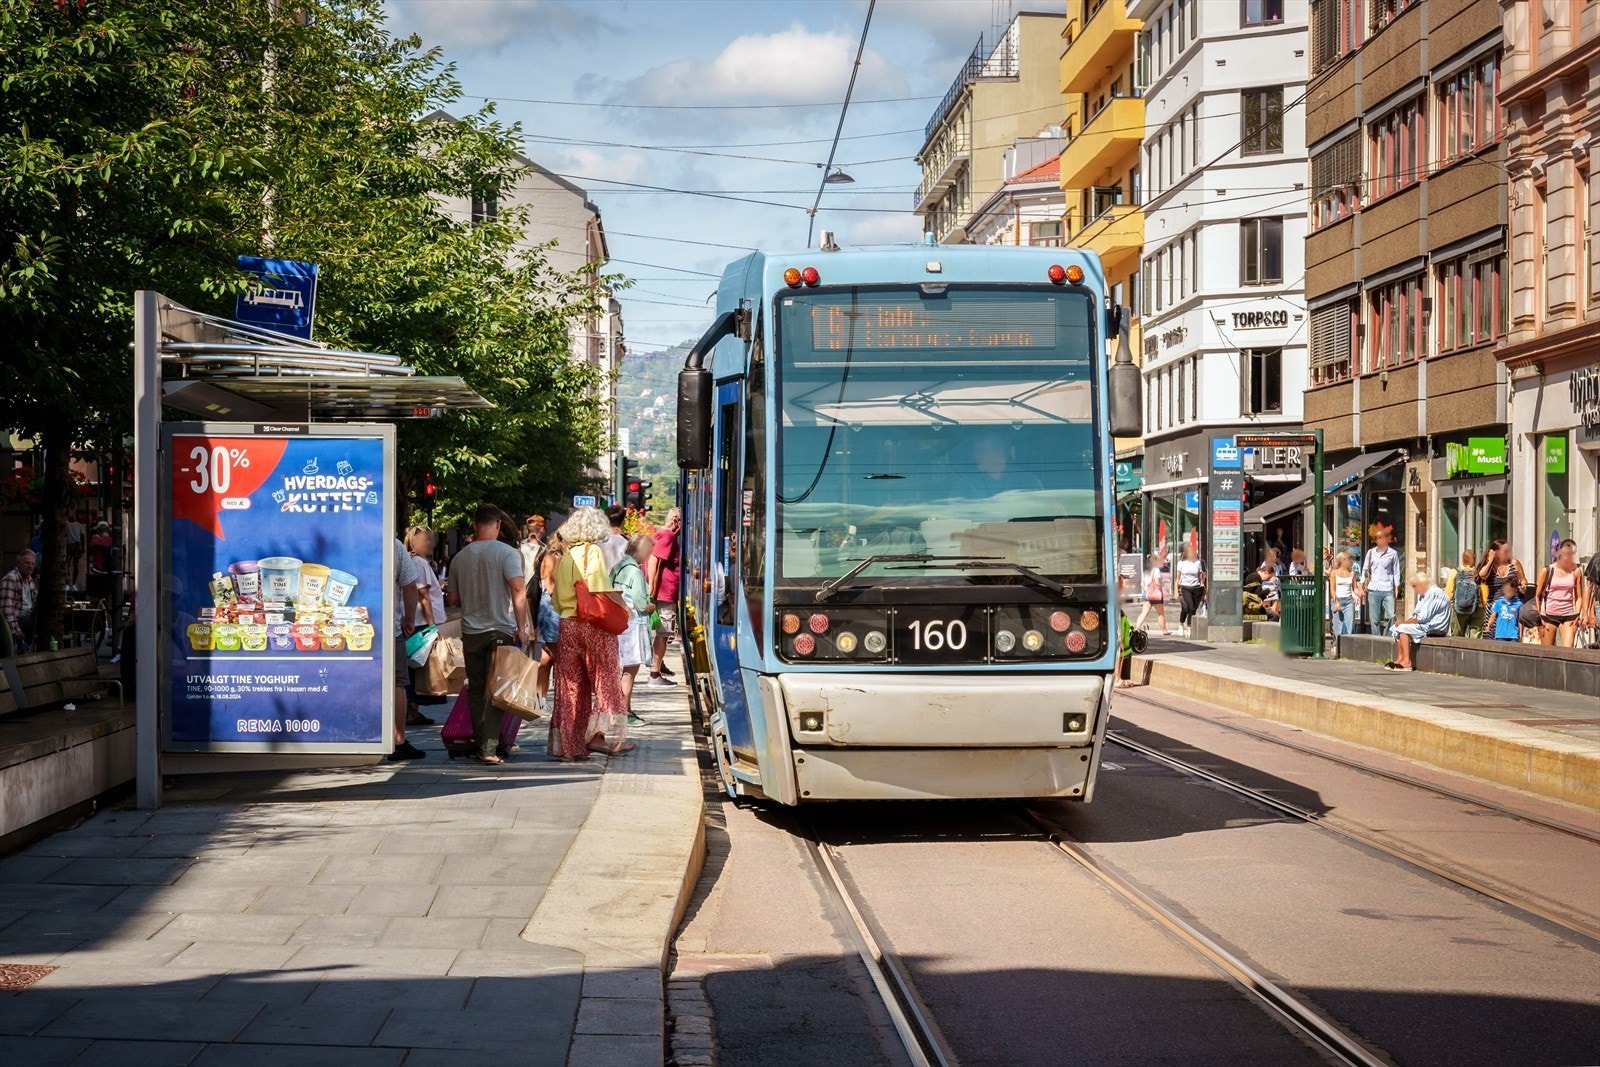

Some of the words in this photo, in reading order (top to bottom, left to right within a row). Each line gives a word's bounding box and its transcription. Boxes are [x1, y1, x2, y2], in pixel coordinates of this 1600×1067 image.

[1231, 310, 1288, 328] TORP&CO
[1477, 456, 1503, 464] Musti
[181, 446, 250, 494] -30%
[284, 475, 373, 491] HVERDAGS-
[332, 587, 344, 595] TINE
[908, 619, 967, 650] 160
[186, 675, 229, 684] UTVALGT
[230, 675, 252, 684] TINE
[254, 675, 300, 684] YOGHURT
[237, 719, 282, 733] REMA
[285, 719, 320, 733] 1000
